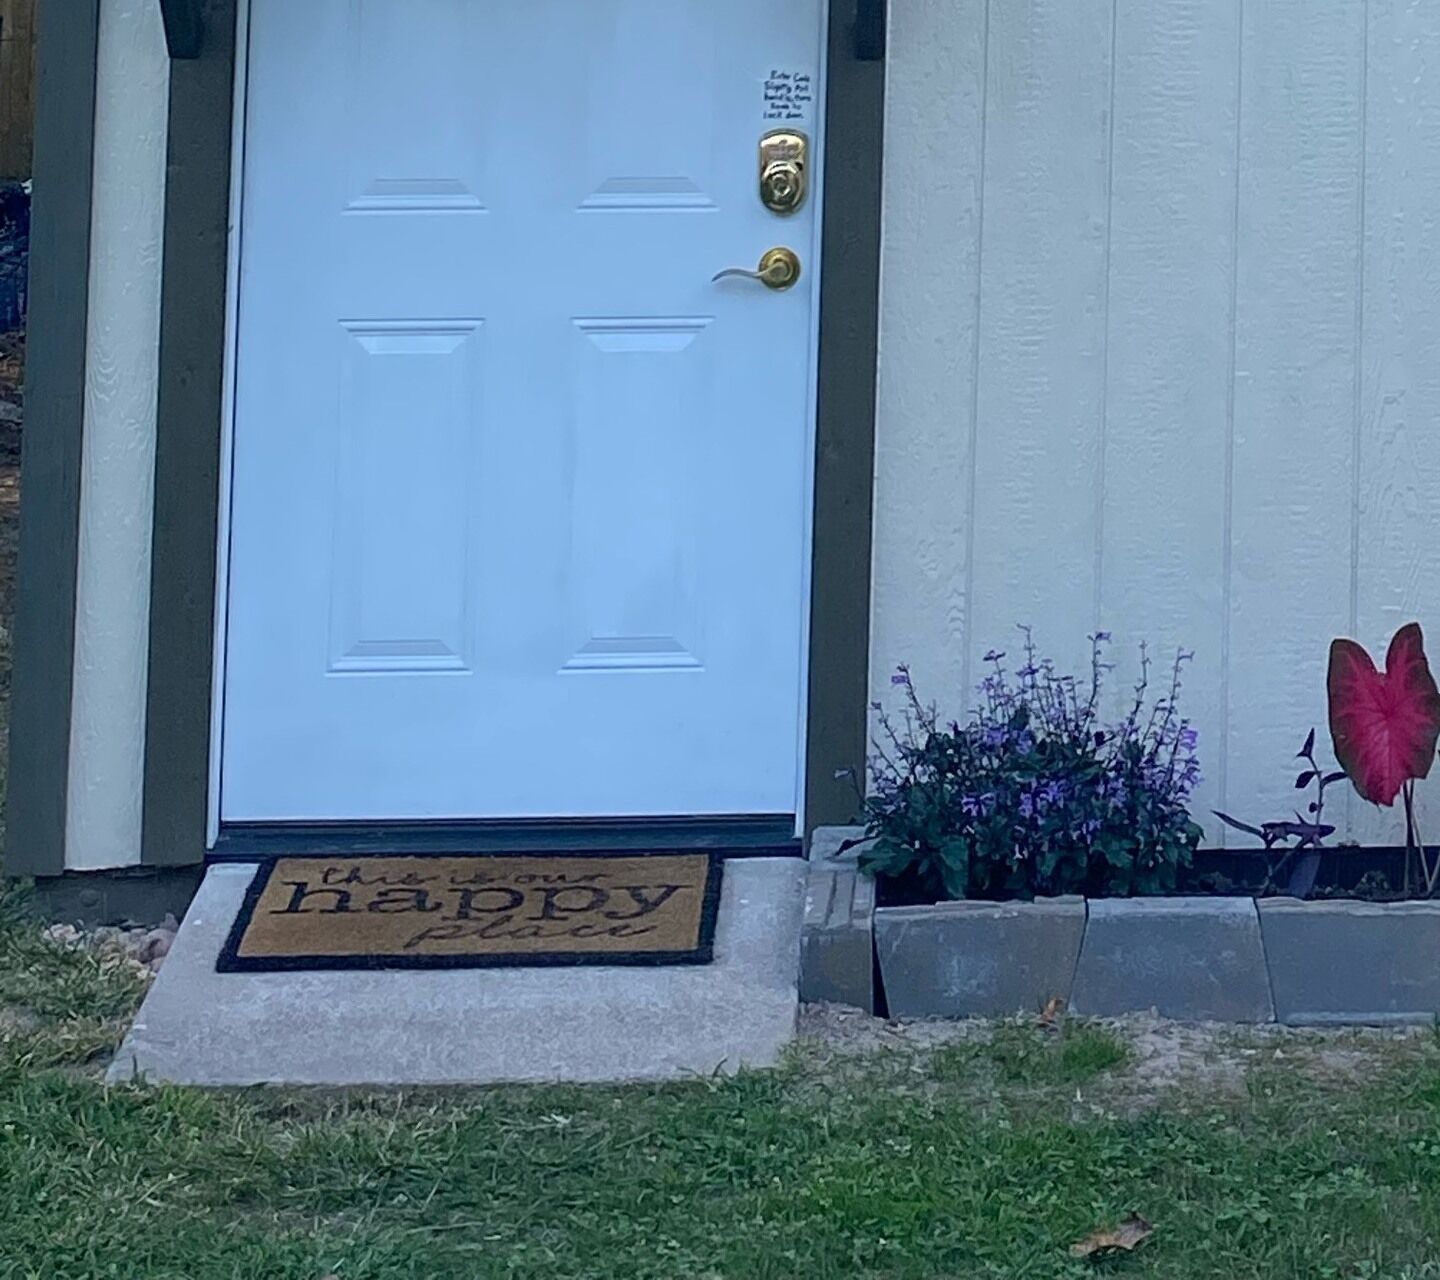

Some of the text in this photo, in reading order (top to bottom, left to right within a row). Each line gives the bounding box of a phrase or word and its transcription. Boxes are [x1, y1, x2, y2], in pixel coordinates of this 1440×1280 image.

[321, 867, 440, 885] this
[513, 873, 613, 885] our
[269, 881, 694, 921] happy
[403, 915, 658, 949] place
